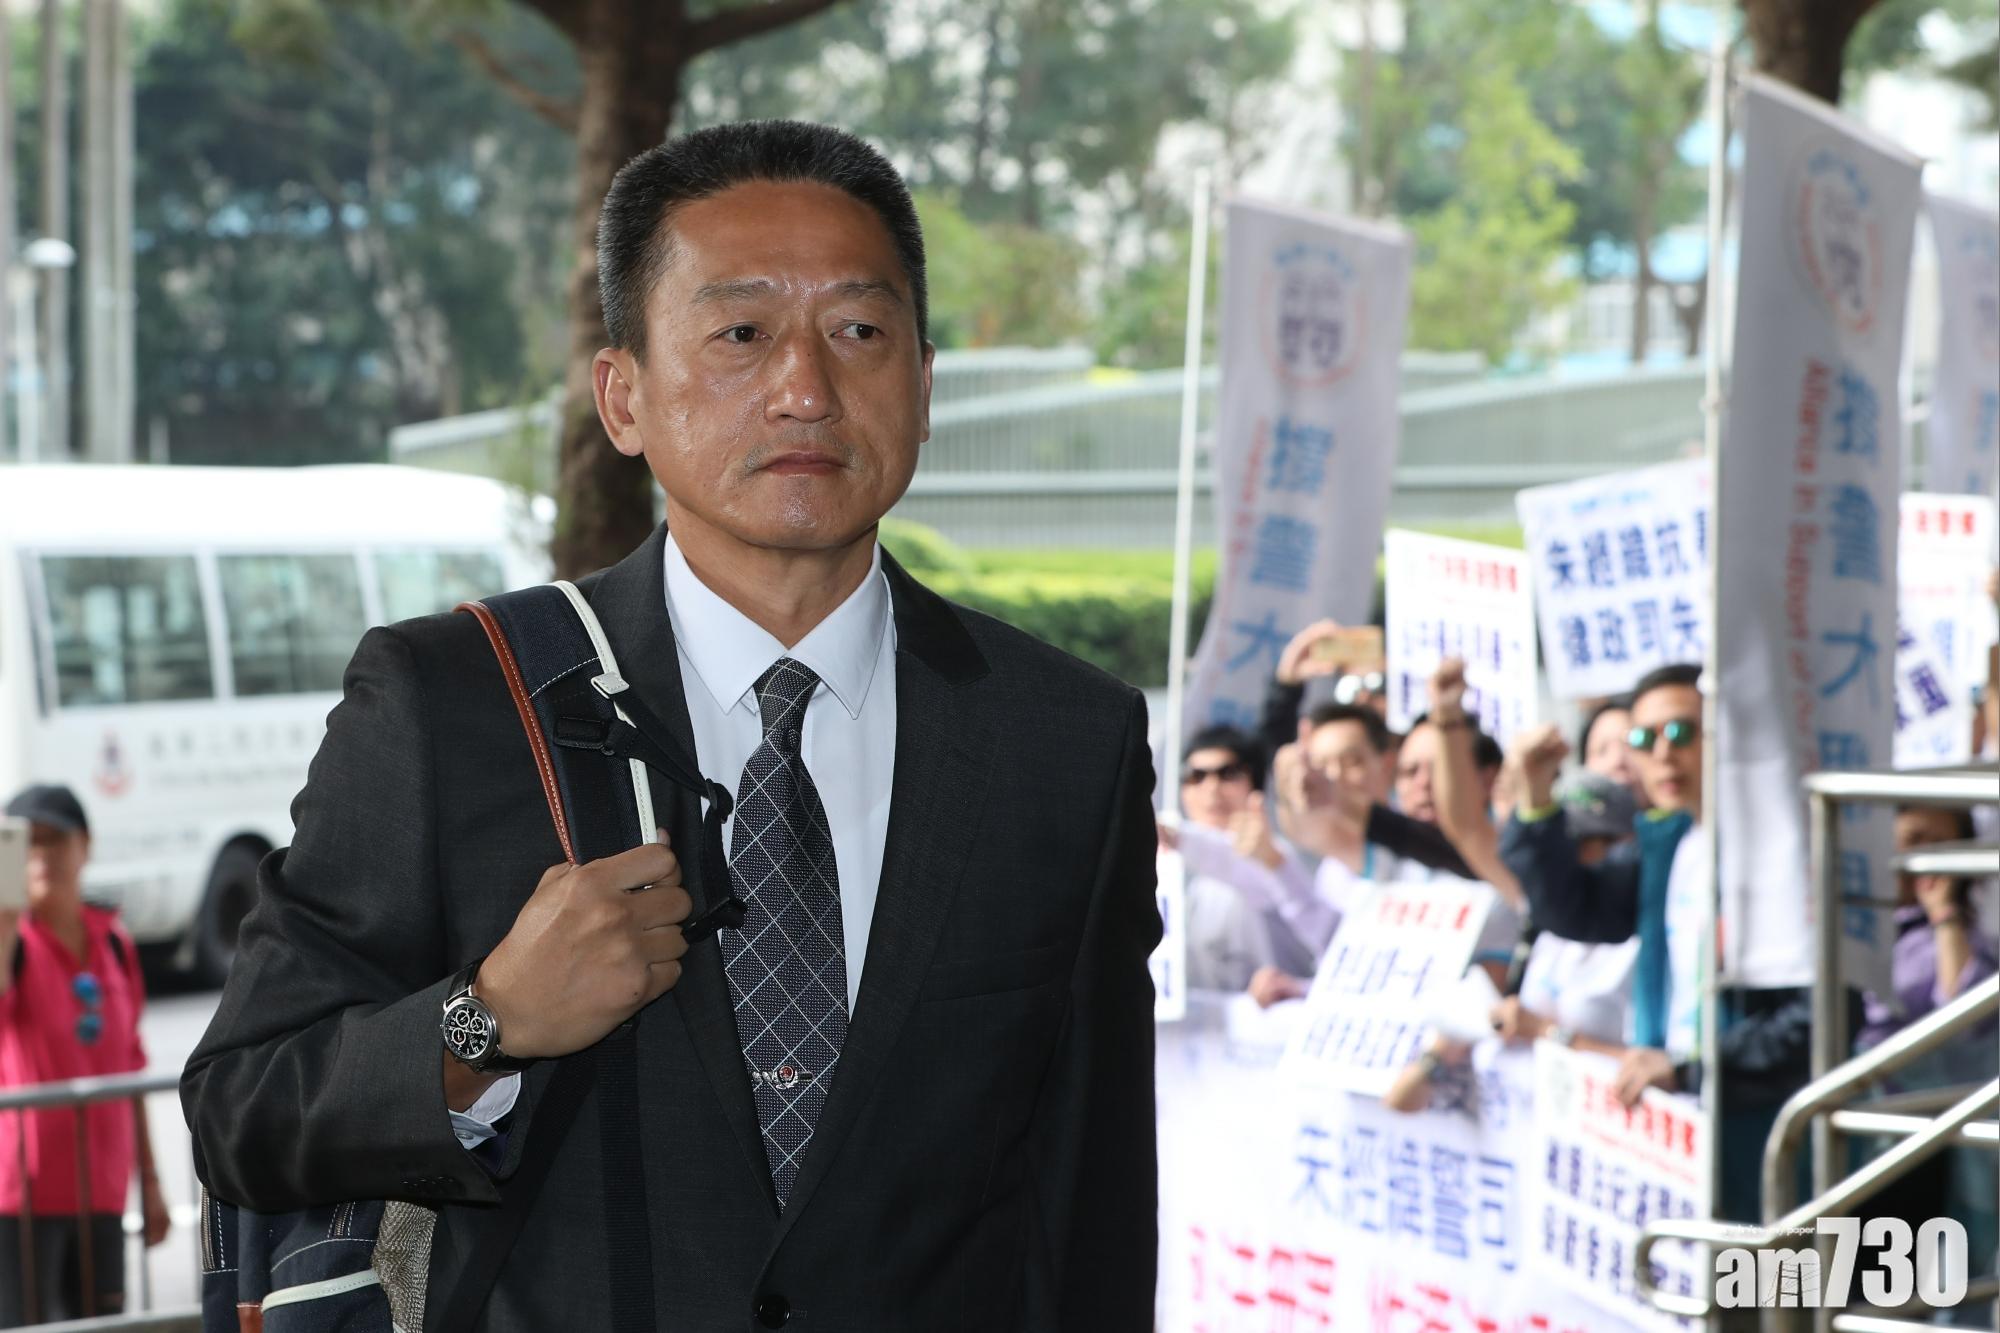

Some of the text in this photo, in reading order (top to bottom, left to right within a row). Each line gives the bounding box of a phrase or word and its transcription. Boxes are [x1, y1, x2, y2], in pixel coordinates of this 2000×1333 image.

[1293, 1124, 1517, 1275] 朱經緯警司
